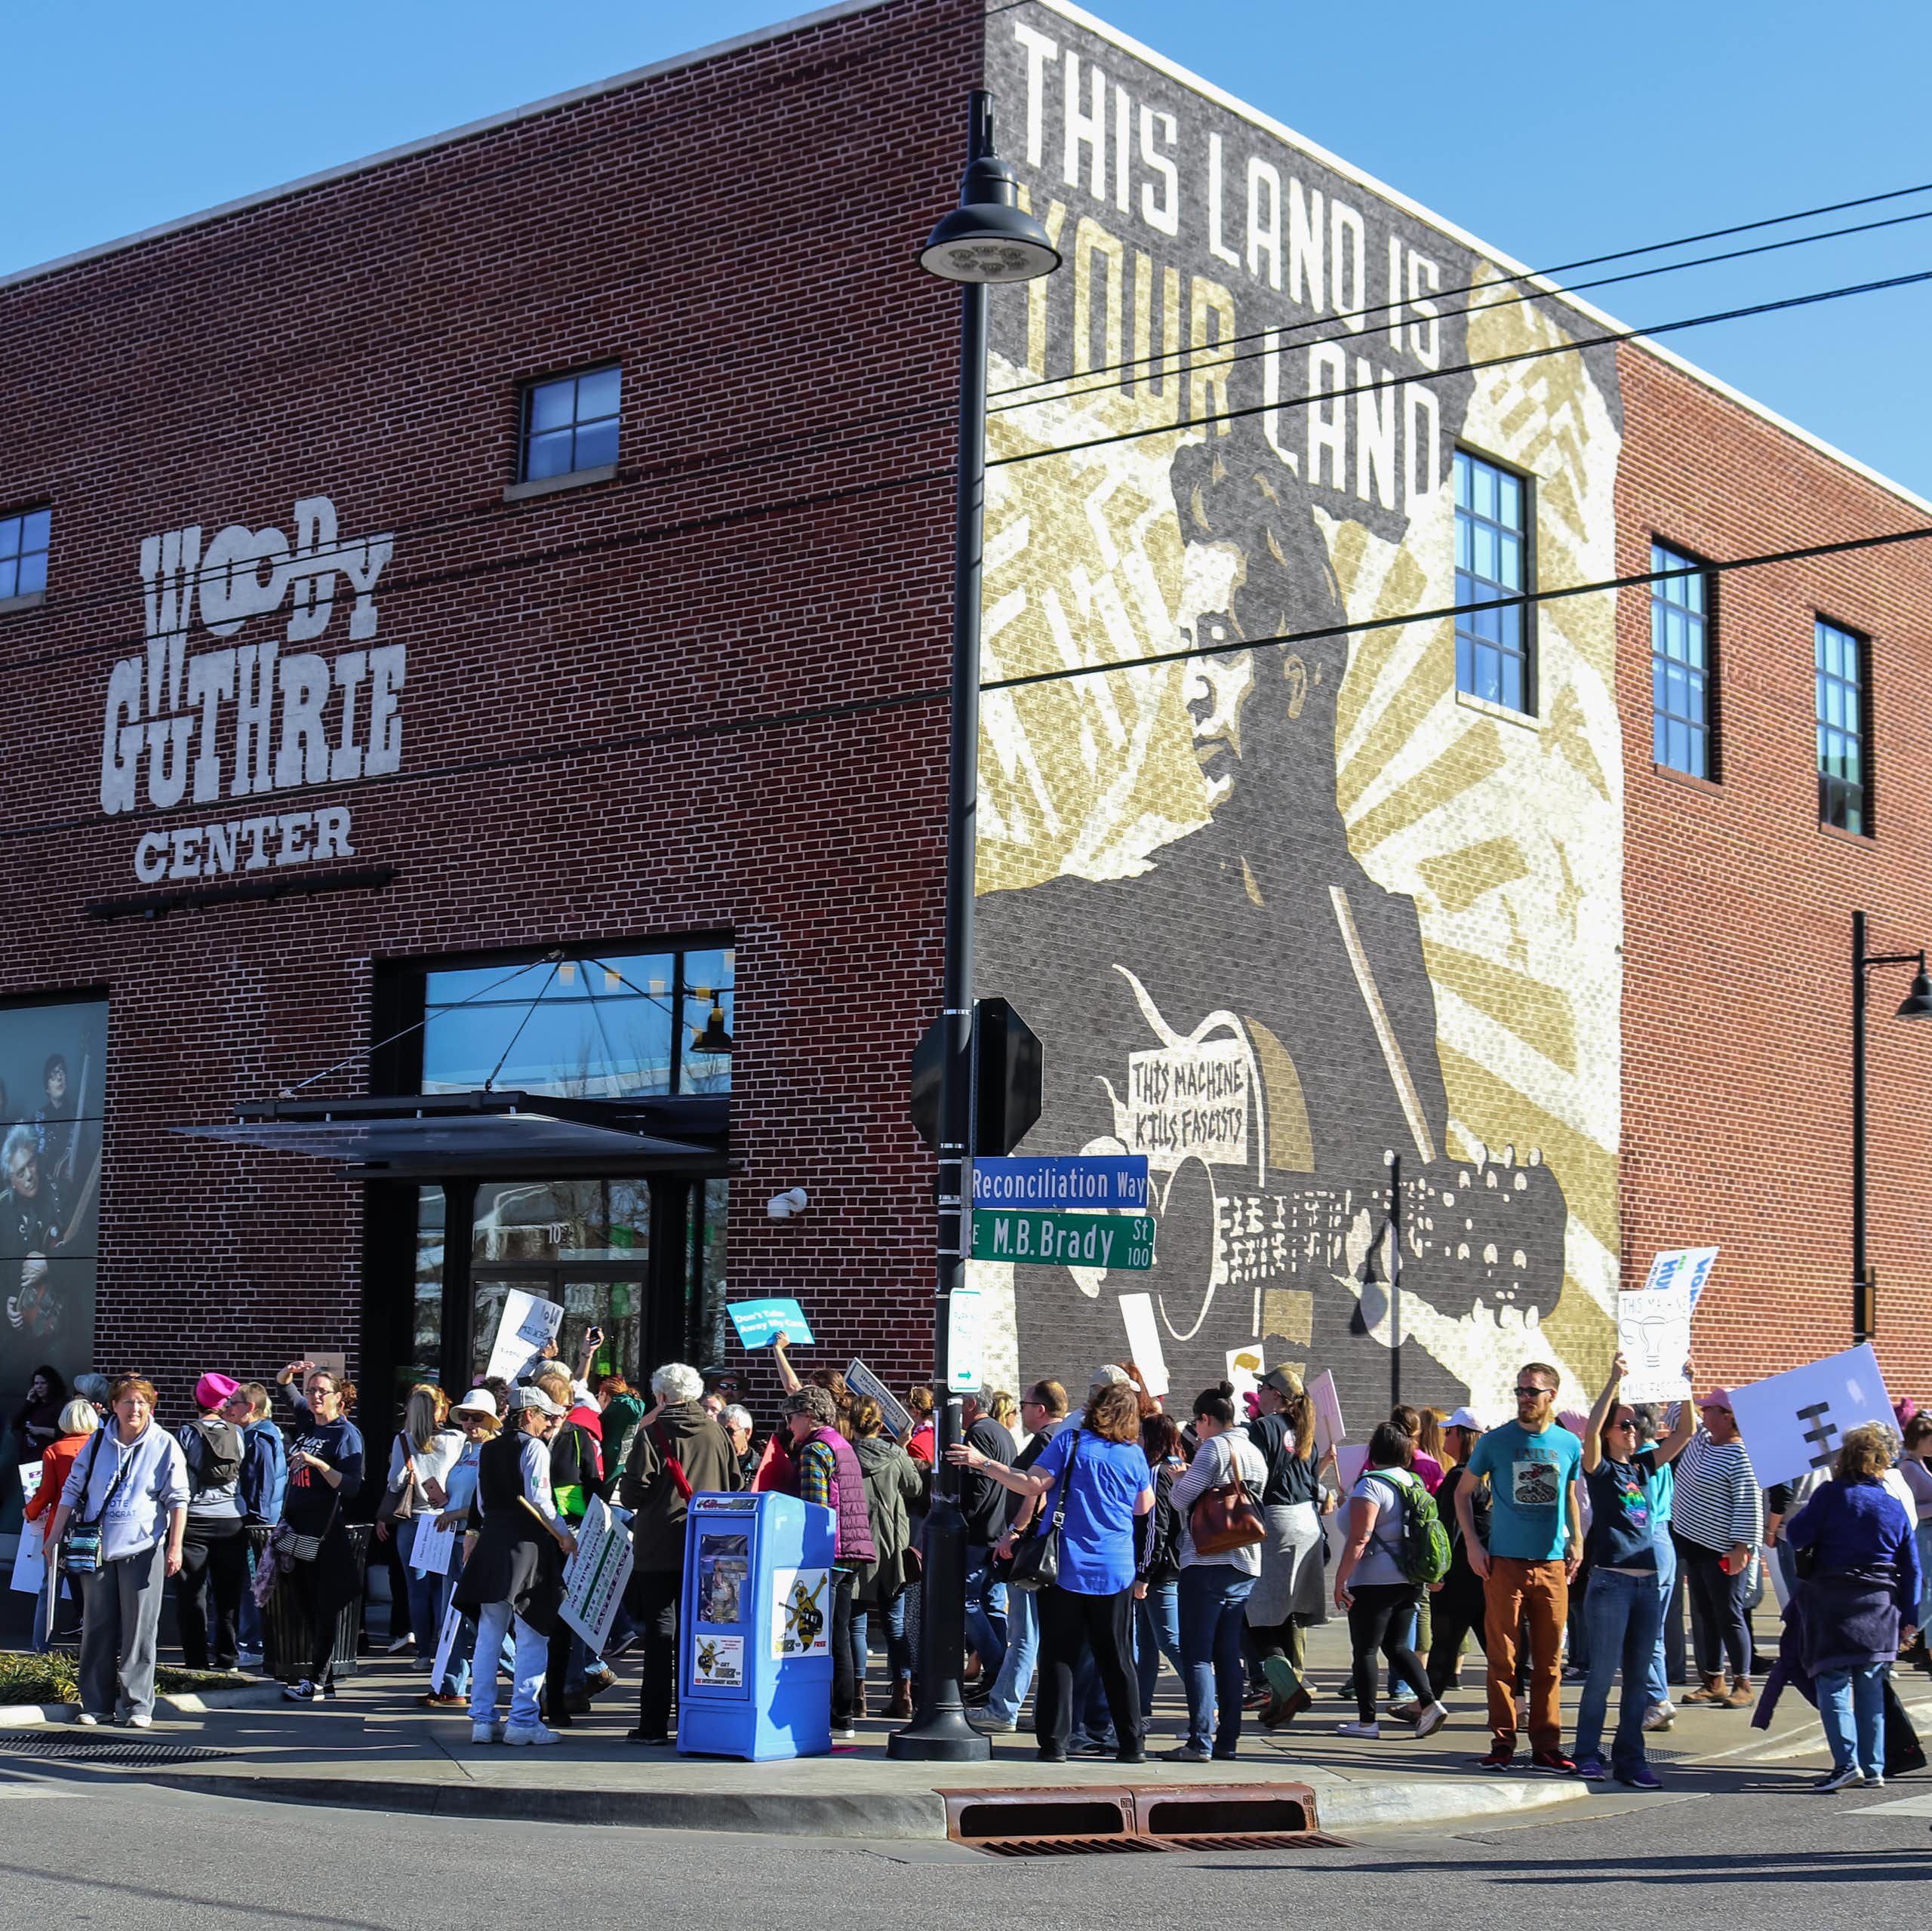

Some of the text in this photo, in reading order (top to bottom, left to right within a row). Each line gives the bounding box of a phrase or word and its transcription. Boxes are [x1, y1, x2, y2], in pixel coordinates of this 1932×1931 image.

[1014, 20, 1440, 371] THIS LAND IS
[1017, 181, 1441, 521] YOUR LAND
[140, 496, 395, 717] WOODY
[100, 643, 407, 816] GUTHRIE
[134, 806, 355, 884] CENTER
[1132, 1058, 1244, 1105] THIS MACHINE
[1135, 1106, 1243, 1152] KILLS FASCISTS
[972, 1167, 1146, 1204] Reconciliation Way
[972, 1223, 980, 1245] E
[1133, 1219, 1149, 1241] St
[1128, 1247, 1149, 1267] 100
[109, 1499, 130, 1508] OTE
